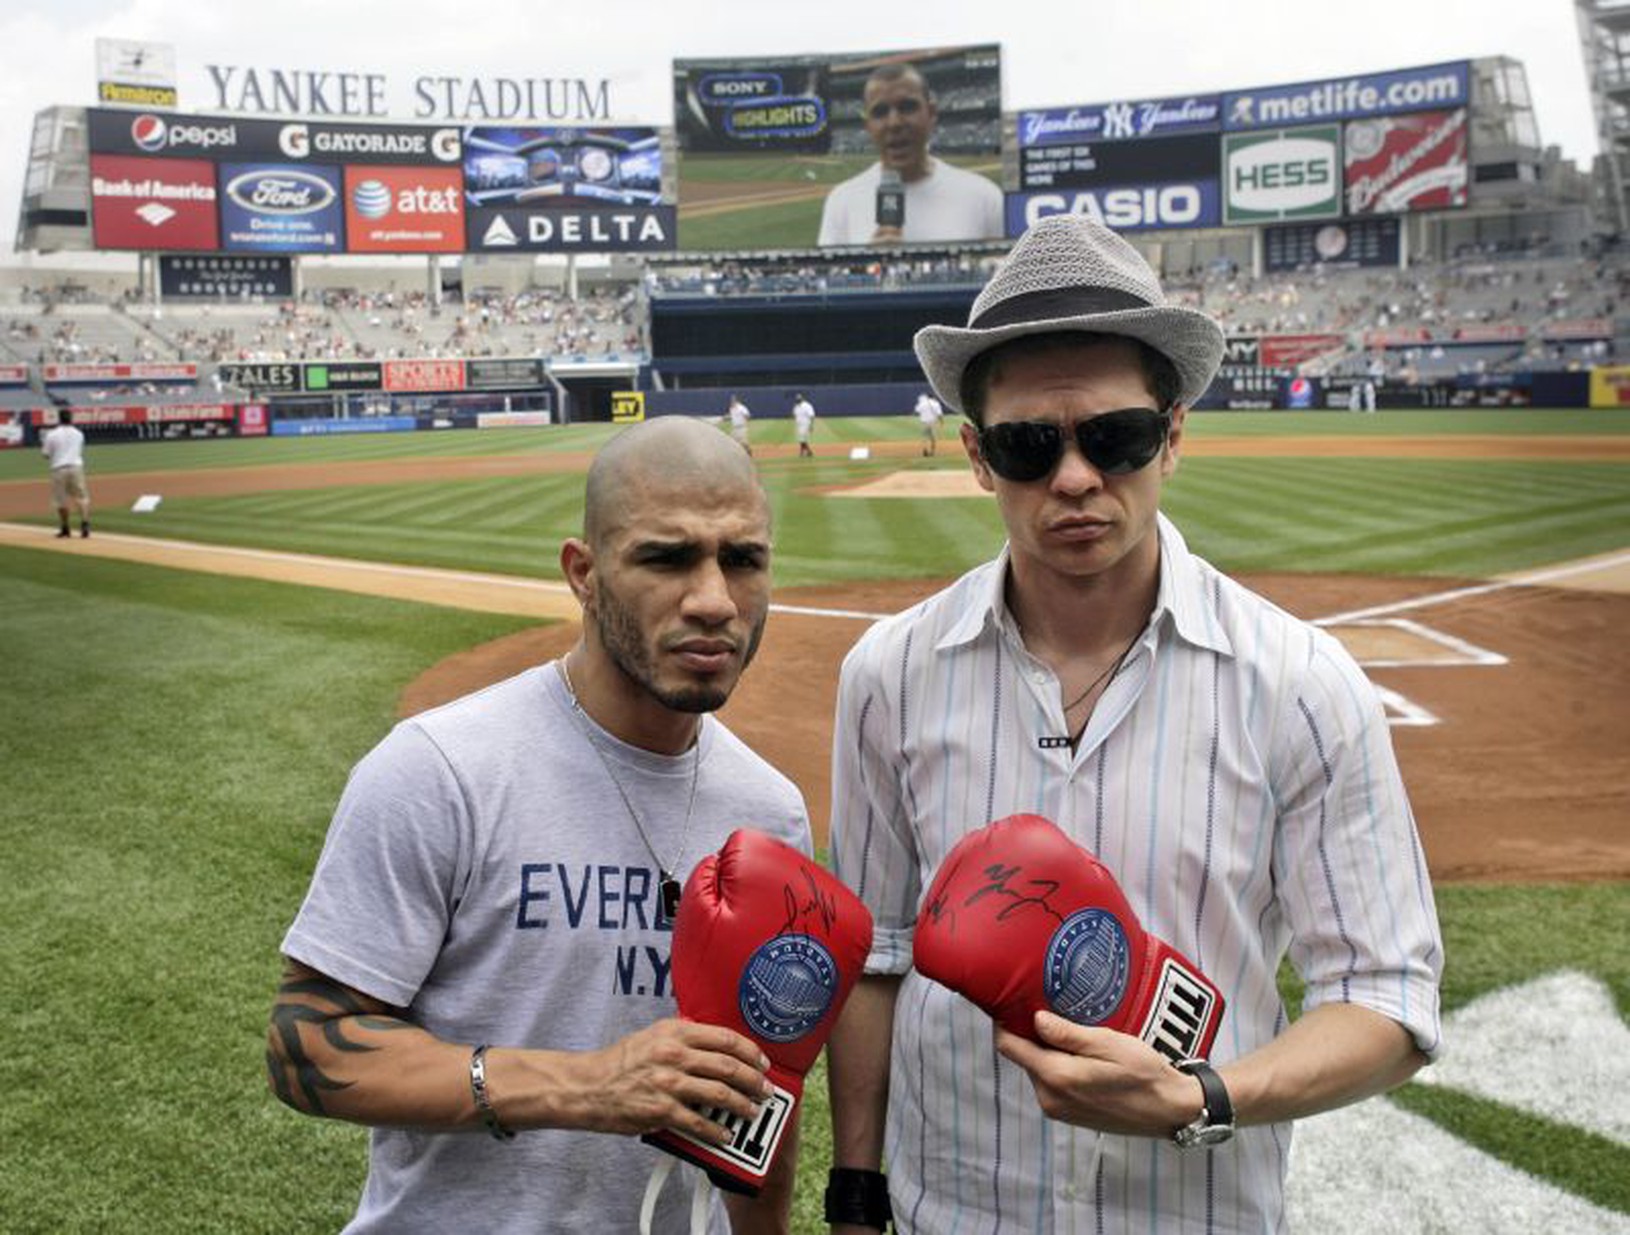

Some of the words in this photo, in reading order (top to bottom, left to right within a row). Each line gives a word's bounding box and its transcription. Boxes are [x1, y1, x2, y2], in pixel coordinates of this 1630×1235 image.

[204, 65, 388, 116] YANKEE
[413, 76, 611, 120] STADIUM
[712, 81, 768, 94] SONY
[1259, 74, 1459, 122] metlife.com
[1023, 110, 1101, 144] Yankees
[1139, 99, 1218, 136] Yankees
[169, 125, 236, 148] pepsi
[314, 132, 426, 153] GATORADE
[92, 177, 131, 197] Bank
[133, 179, 152, 198] of
[151, 180, 216, 200] America
[1235, 157, 1329, 192] HESS
[252, 179, 311, 206] Ford
[397, 185, 459, 214] at&t
[1025, 185, 1201, 228] CASIO
[528, 214, 665, 243] DELTA
[229, 365, 294, 385] ZALES
